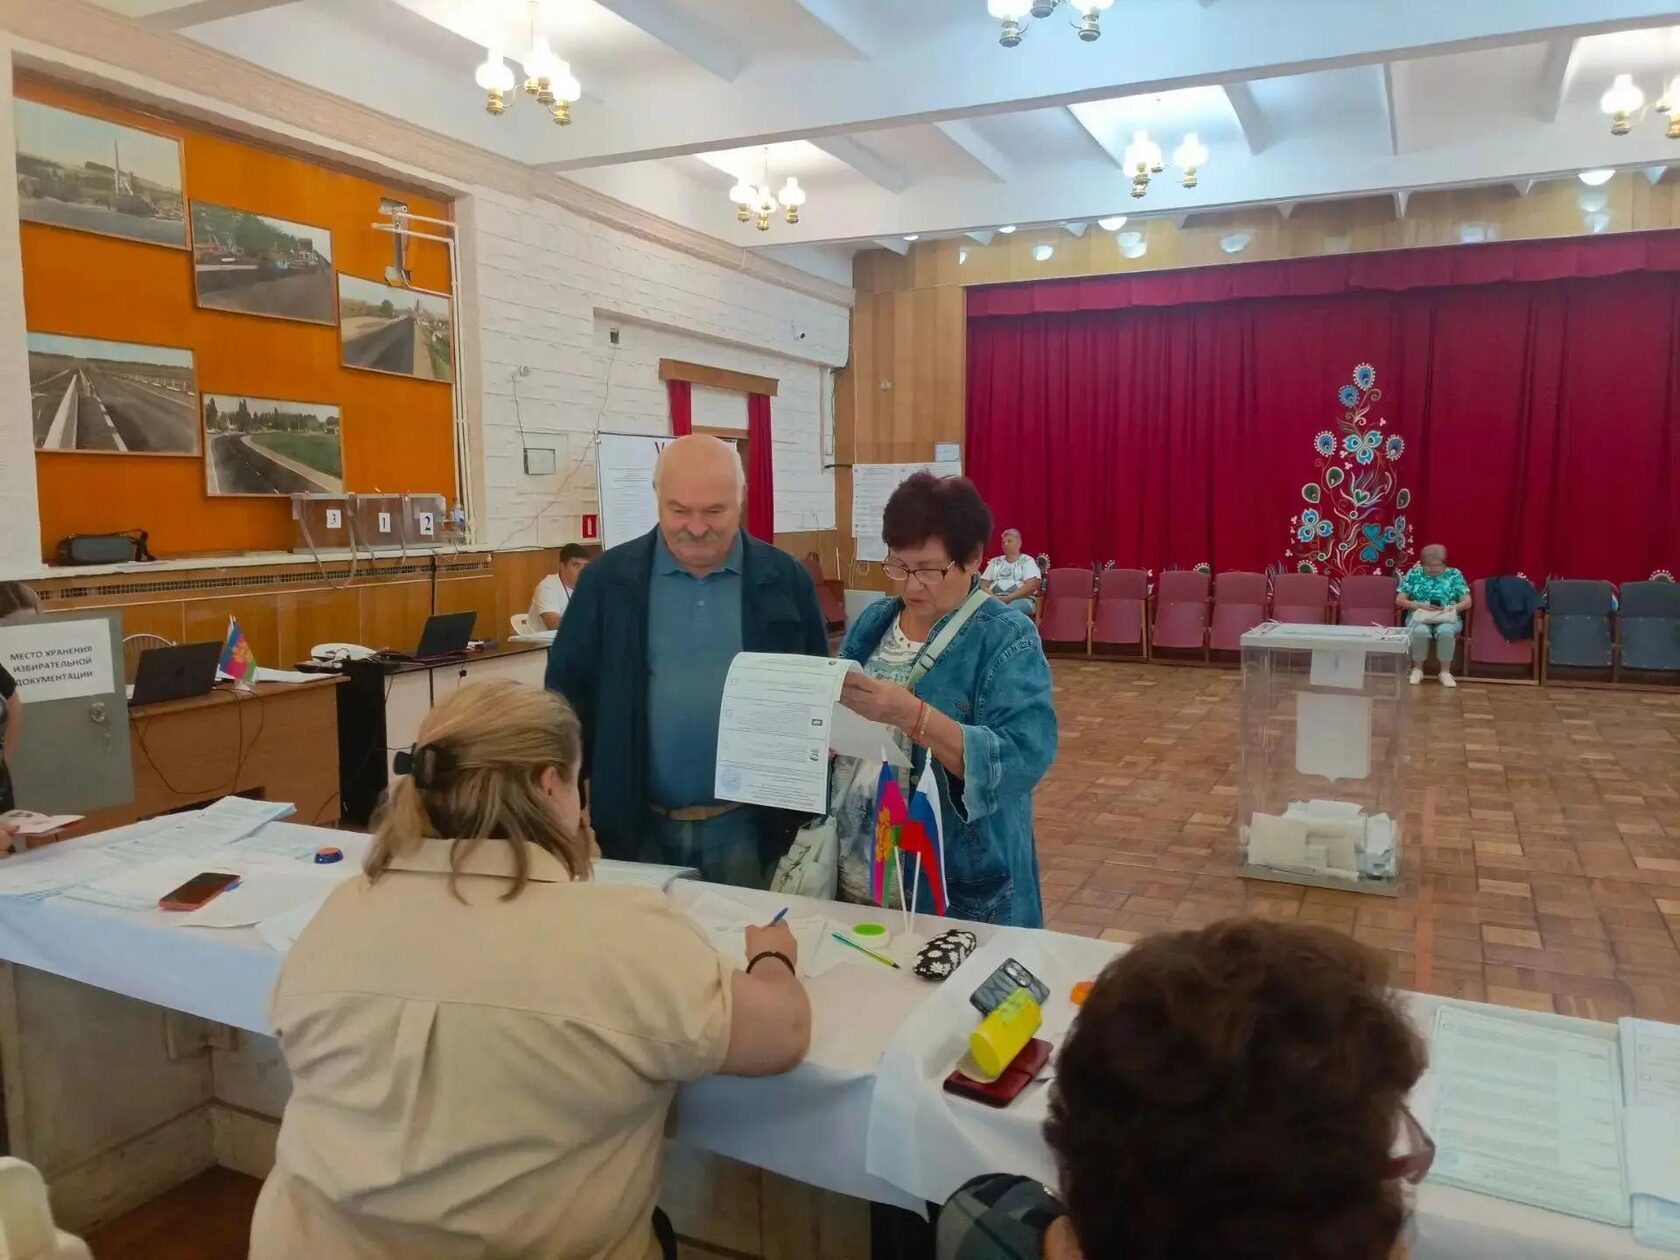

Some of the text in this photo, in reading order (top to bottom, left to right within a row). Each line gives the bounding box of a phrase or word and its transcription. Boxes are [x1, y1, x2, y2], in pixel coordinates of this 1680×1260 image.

[423, 515, 431, 531] 2
[9, 645, 93, 661] МЕСТО ХРАНЕНИЯ
[13, 657, 92, 673] ИЗБИРАТЕЛЬНОЙ
[15, 671, 93, 687] ДОКУМЕНТАЦИИ
